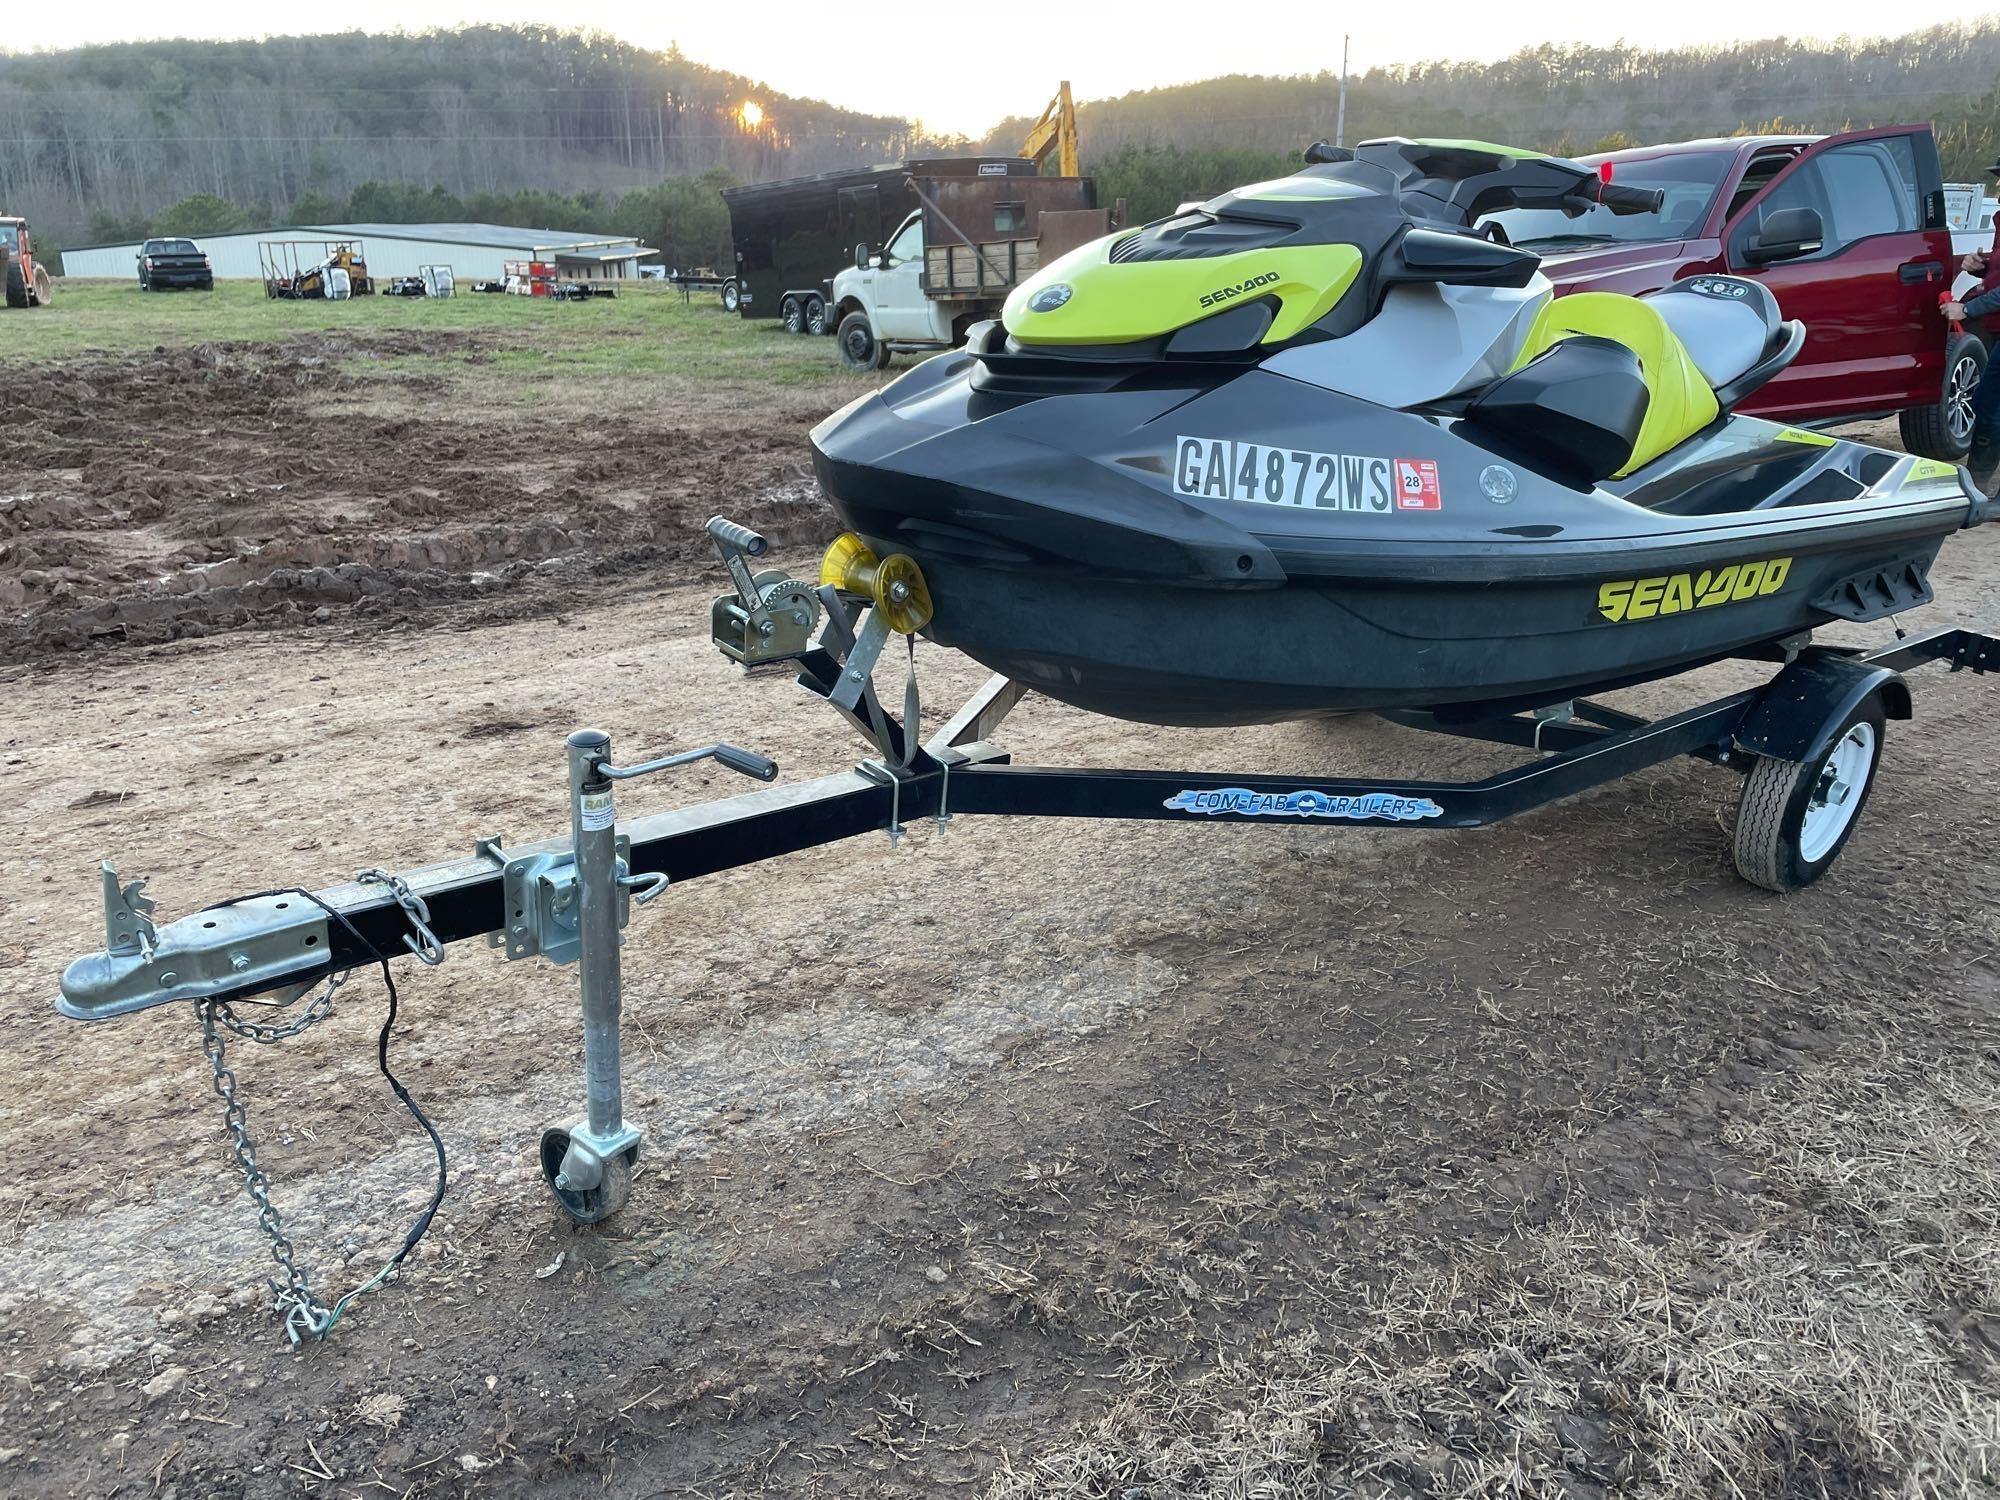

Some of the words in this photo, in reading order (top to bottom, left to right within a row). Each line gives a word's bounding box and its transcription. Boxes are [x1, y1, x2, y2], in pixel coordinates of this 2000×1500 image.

[1405, 476, 1420, 487] 28
[1194, 792, 1288, 810] COM-FAB
[1326, 797, 1419, 815] TRAILERS
